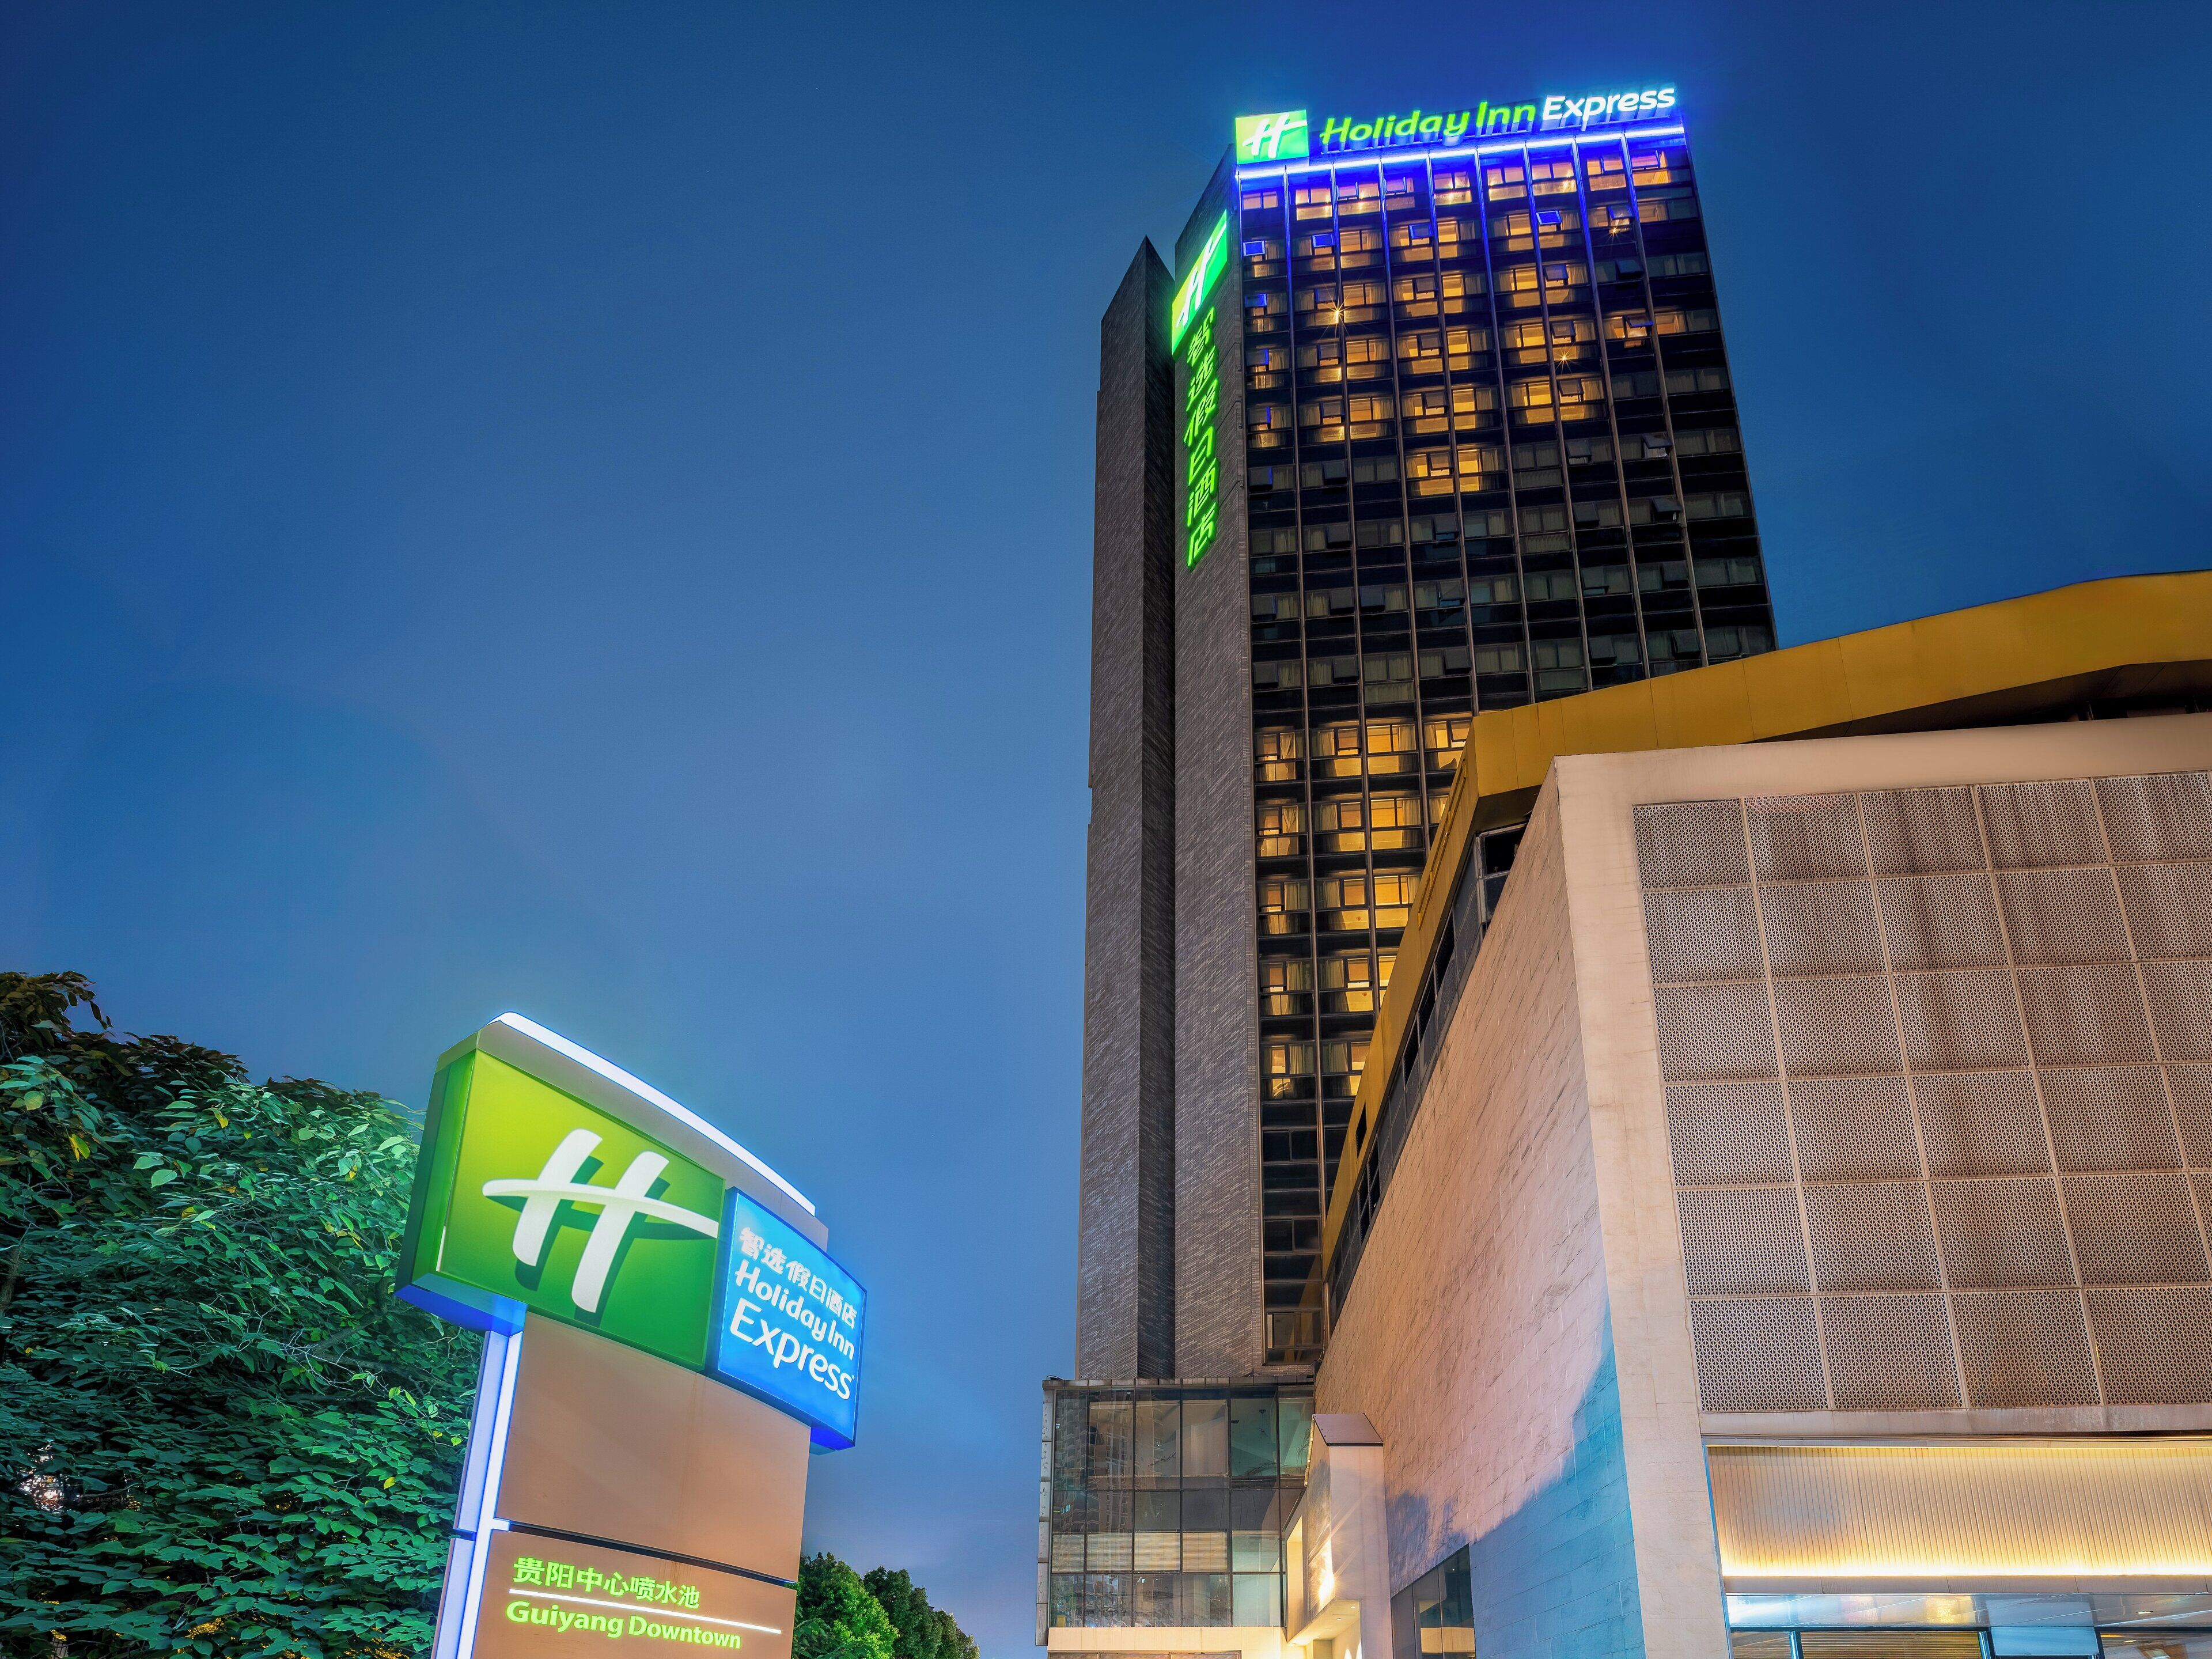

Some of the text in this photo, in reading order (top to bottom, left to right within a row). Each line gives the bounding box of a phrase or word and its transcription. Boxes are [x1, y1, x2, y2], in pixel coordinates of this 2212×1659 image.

[1320, 88, 1675, 143] Holiday Inn Express
[1184, 306, 1218, 567] 智选假日酒店
[734, 1259, 855, 1359] Holiday Inn
[739, 1227, 856, 1328] 智选假日酒店
[730, 1298, 853, 1400] Express
[506, 1601, 741, 1649] Guiyang Downtown
[513, 1556, 700, 1609] 贵阳中心喷水池
